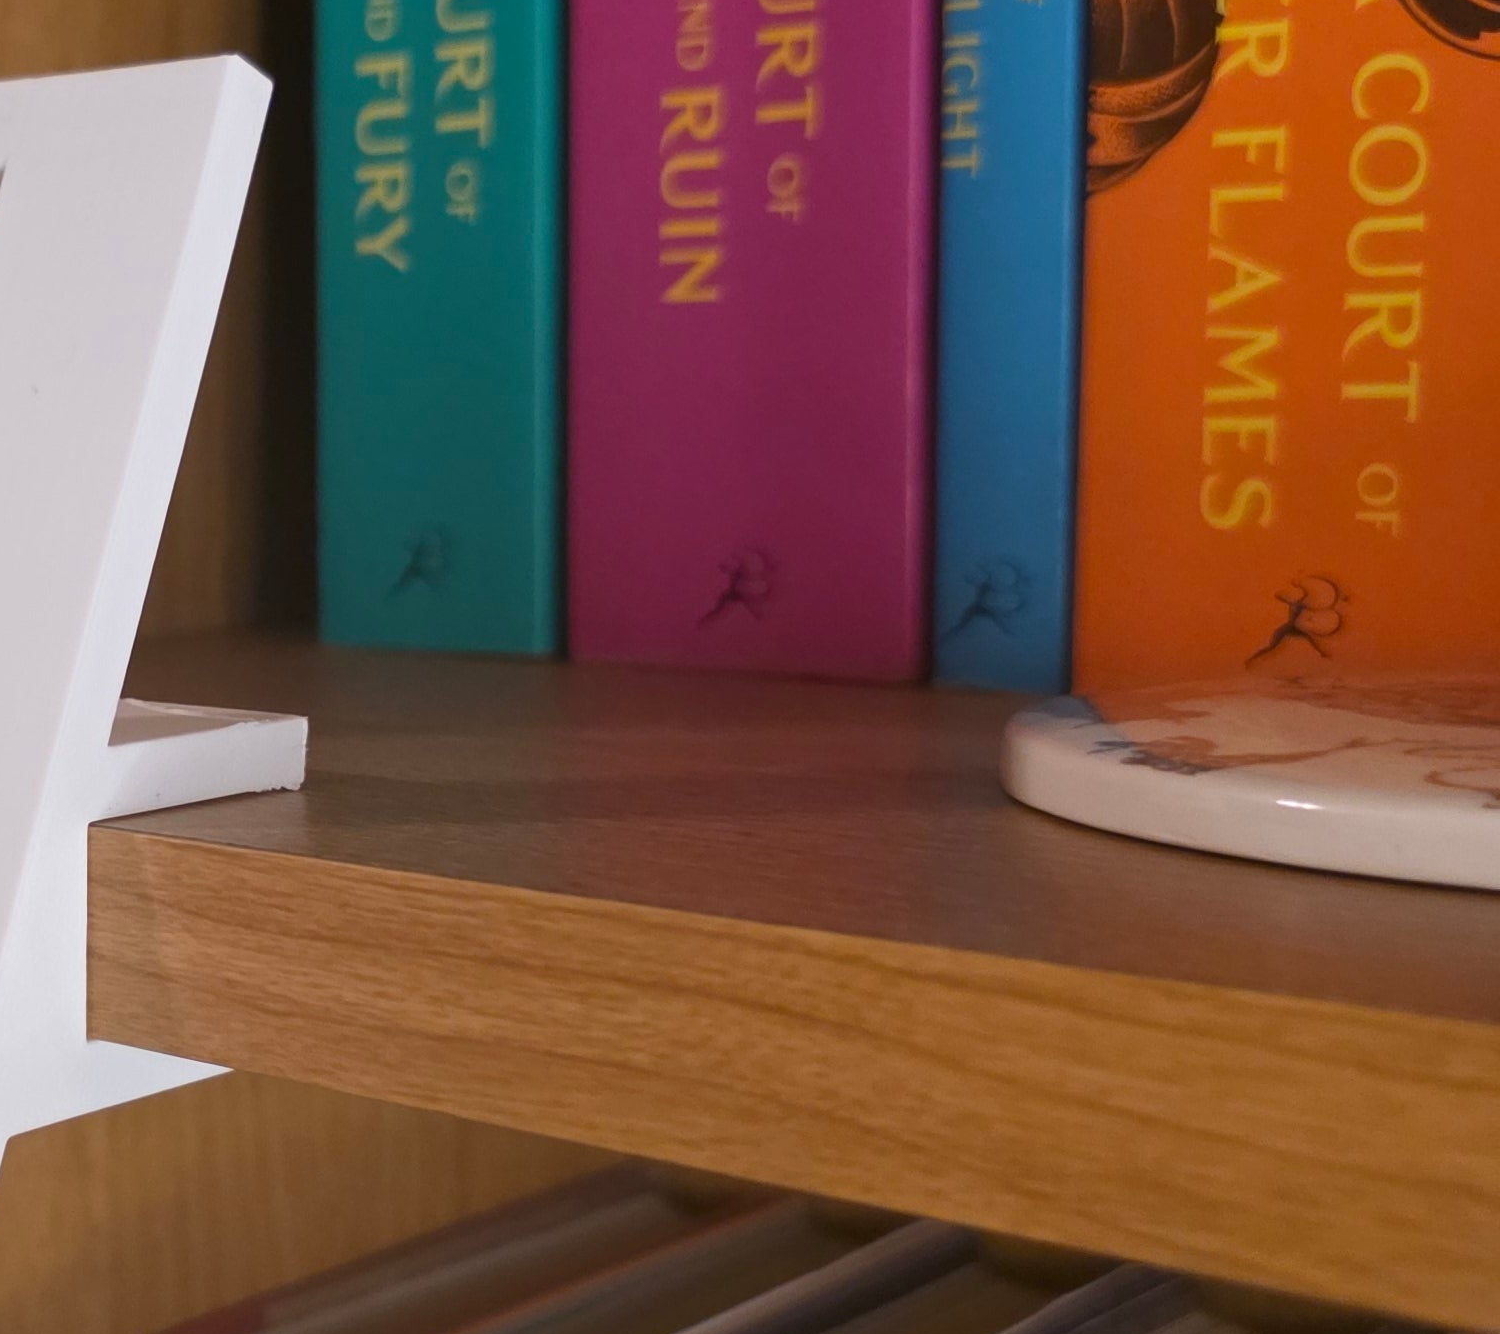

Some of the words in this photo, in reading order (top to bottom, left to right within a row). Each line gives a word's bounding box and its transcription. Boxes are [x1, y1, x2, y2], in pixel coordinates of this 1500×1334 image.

[354, 50, 413, 272] FURY
[445, 162, 479, 225] OF
[659, 86, 724, 304] RUIN
[766, 154, 802, 222] OF
[1340, 53, 1431, 423] COURT
[1200, 124, 1288, 531] FLAMES
[1353, 463, 1401, 540] OF
